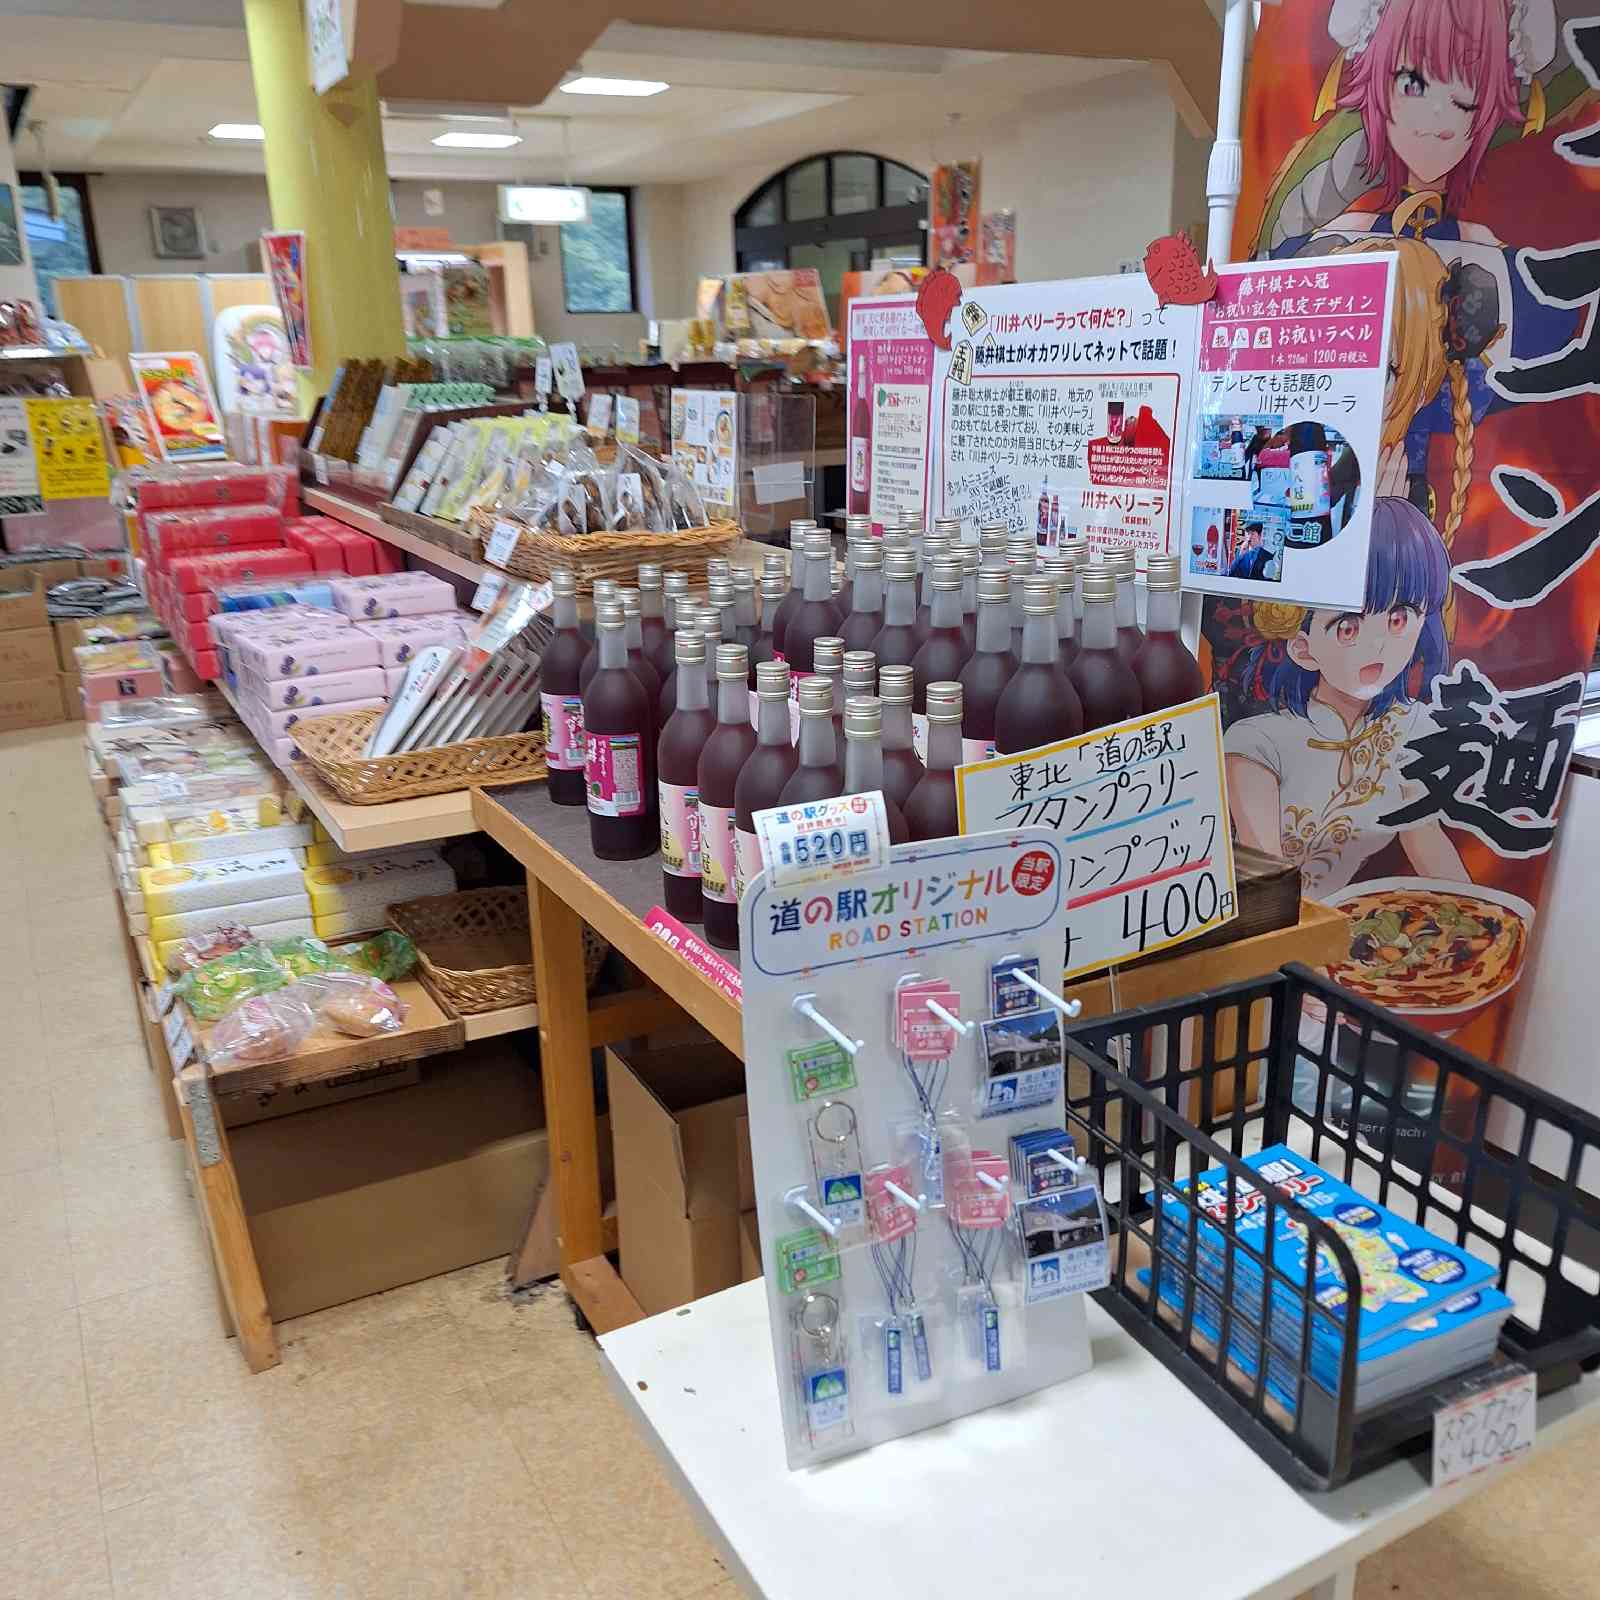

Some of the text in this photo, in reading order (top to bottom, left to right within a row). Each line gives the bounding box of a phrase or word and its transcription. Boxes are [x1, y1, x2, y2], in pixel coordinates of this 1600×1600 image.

[1238, 271, 1330, 296] 藤井棋士八冠
[1215, 295, 1374, 318] お祝い記念限定デザイン
[1278, 324, 1373, 346] お祝いラベル
[1314, 350, 1336, 364] 1200
[1211, 374, 1333, 393] テレビでも話題の
[1258, 395, 1358, 413] 川井ペリーラ
[1082, 490, 1166, 517] 川井ペリーラ
[795, 830, 869, 863] 520円
[769, 866, 1010, 937] 道の駅オリジナル
[1122, 871, 1234, 953] 400円
[827, 907, 988, 951] ROAD STATION
